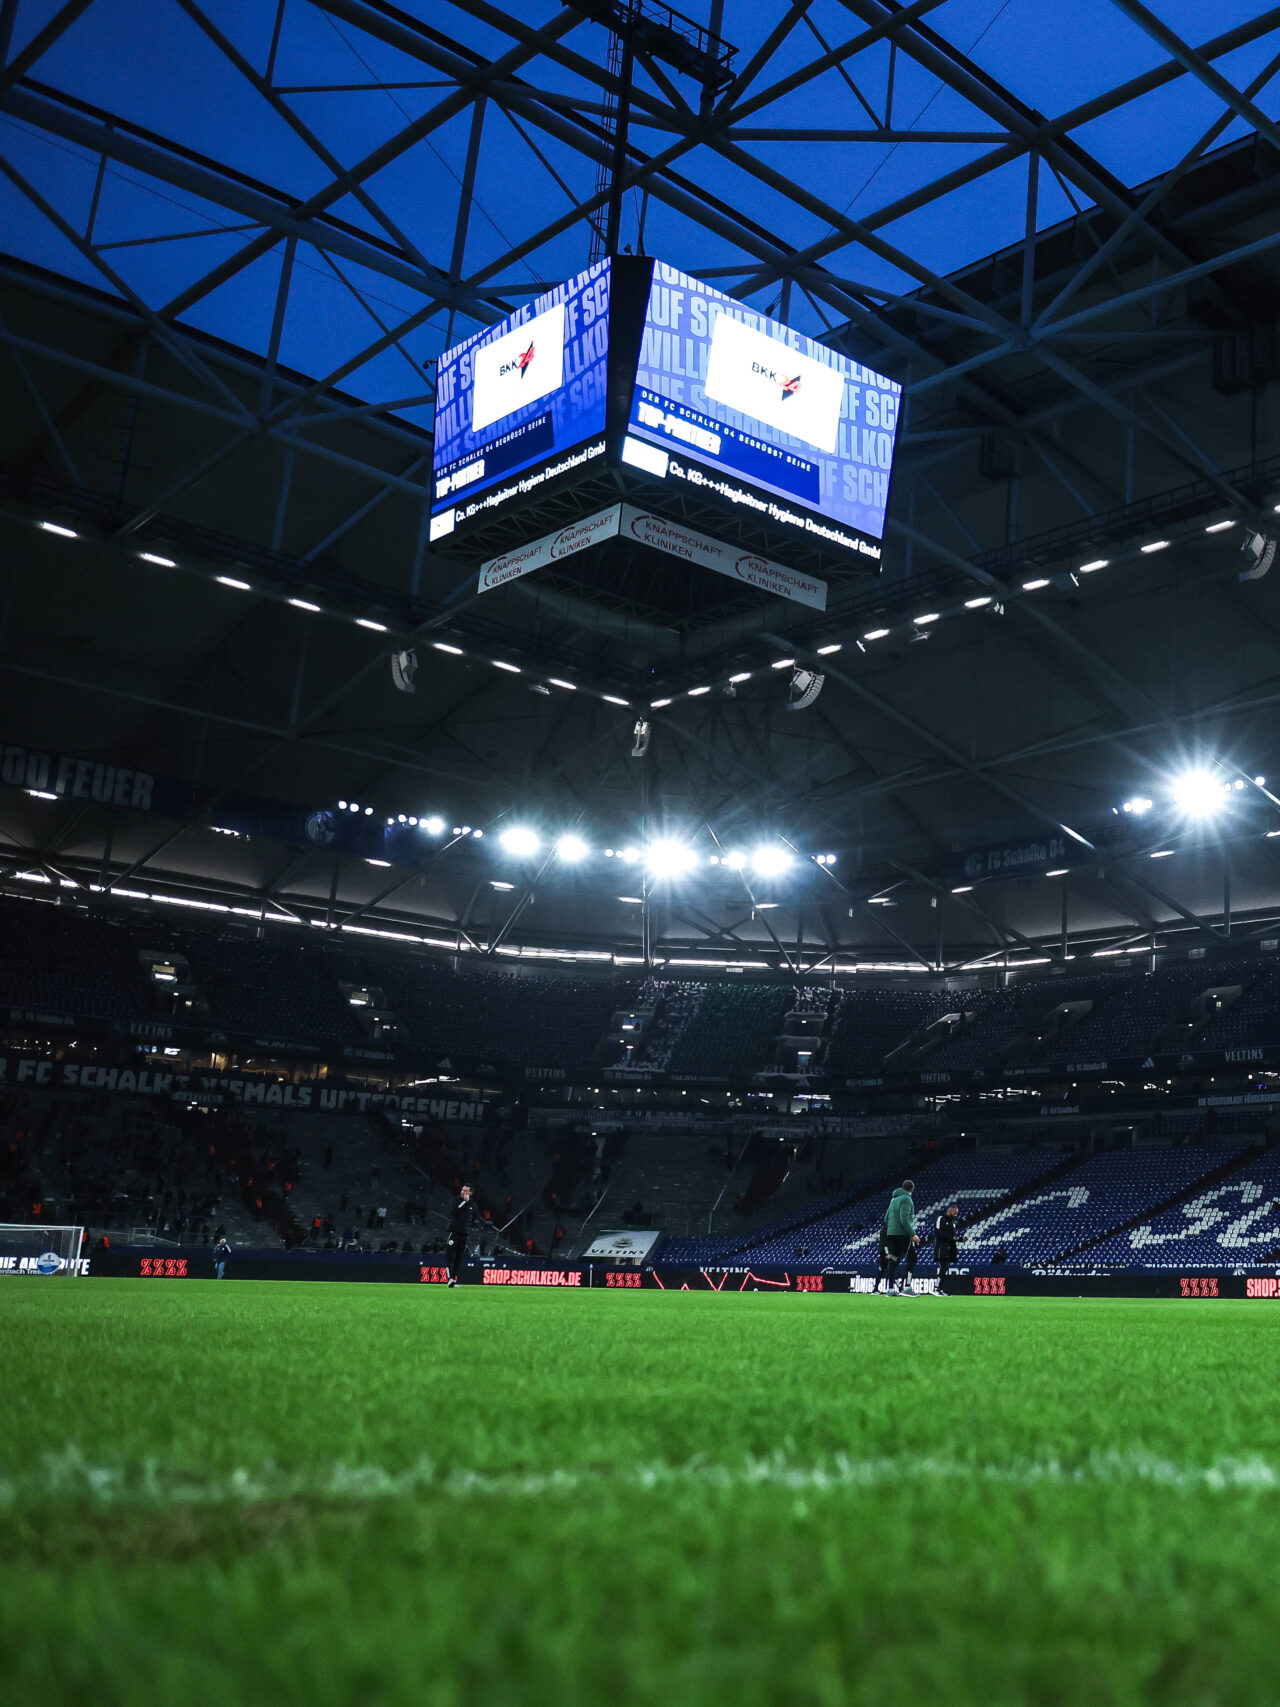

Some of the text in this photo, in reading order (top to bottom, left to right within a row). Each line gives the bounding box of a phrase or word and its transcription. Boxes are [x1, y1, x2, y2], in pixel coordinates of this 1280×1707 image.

[642, 391, 660, 404] DER
[664, 400, 675, 411] FC
[680, 408, 720, 431] SCHALKE
[724, 428, 735, 438] 04
[787, 455, 811, 472] SEINE
[437, 467, 448, 477] DER
[450, 462, 457, 471] FC
[459, 451, 484, 467] SCHALKE
[528, 416, 546, 431] SEINE
[669, 461, 686, 479] Co.
[560, 514, 614, 544] KNAPPSCHAFT
[645, 521, 723, 558] KNAPPSCHAFT
[558, 536, 592, 556] KLINIKEN
[644, 533, 693, 558] KLINIKEN
[493, 546, 543, 574] KNAPPSCHAFT
[491, 567, 522, 585] KLINIKEN
[747, 573, 792, 596] KLINIKEN
[748, 561, 820, 594] KNAPPSCHAFT
[56, 756, 155, 810] FEUER
[121, 1021, 173, 1038] ELTINS
[1224, 1048, 1263, 1062] VELTINS
[16, 1059, 53, 1083] FC
[482, 1268, 582, 1286] SHOP.SCHALKE04.DE
